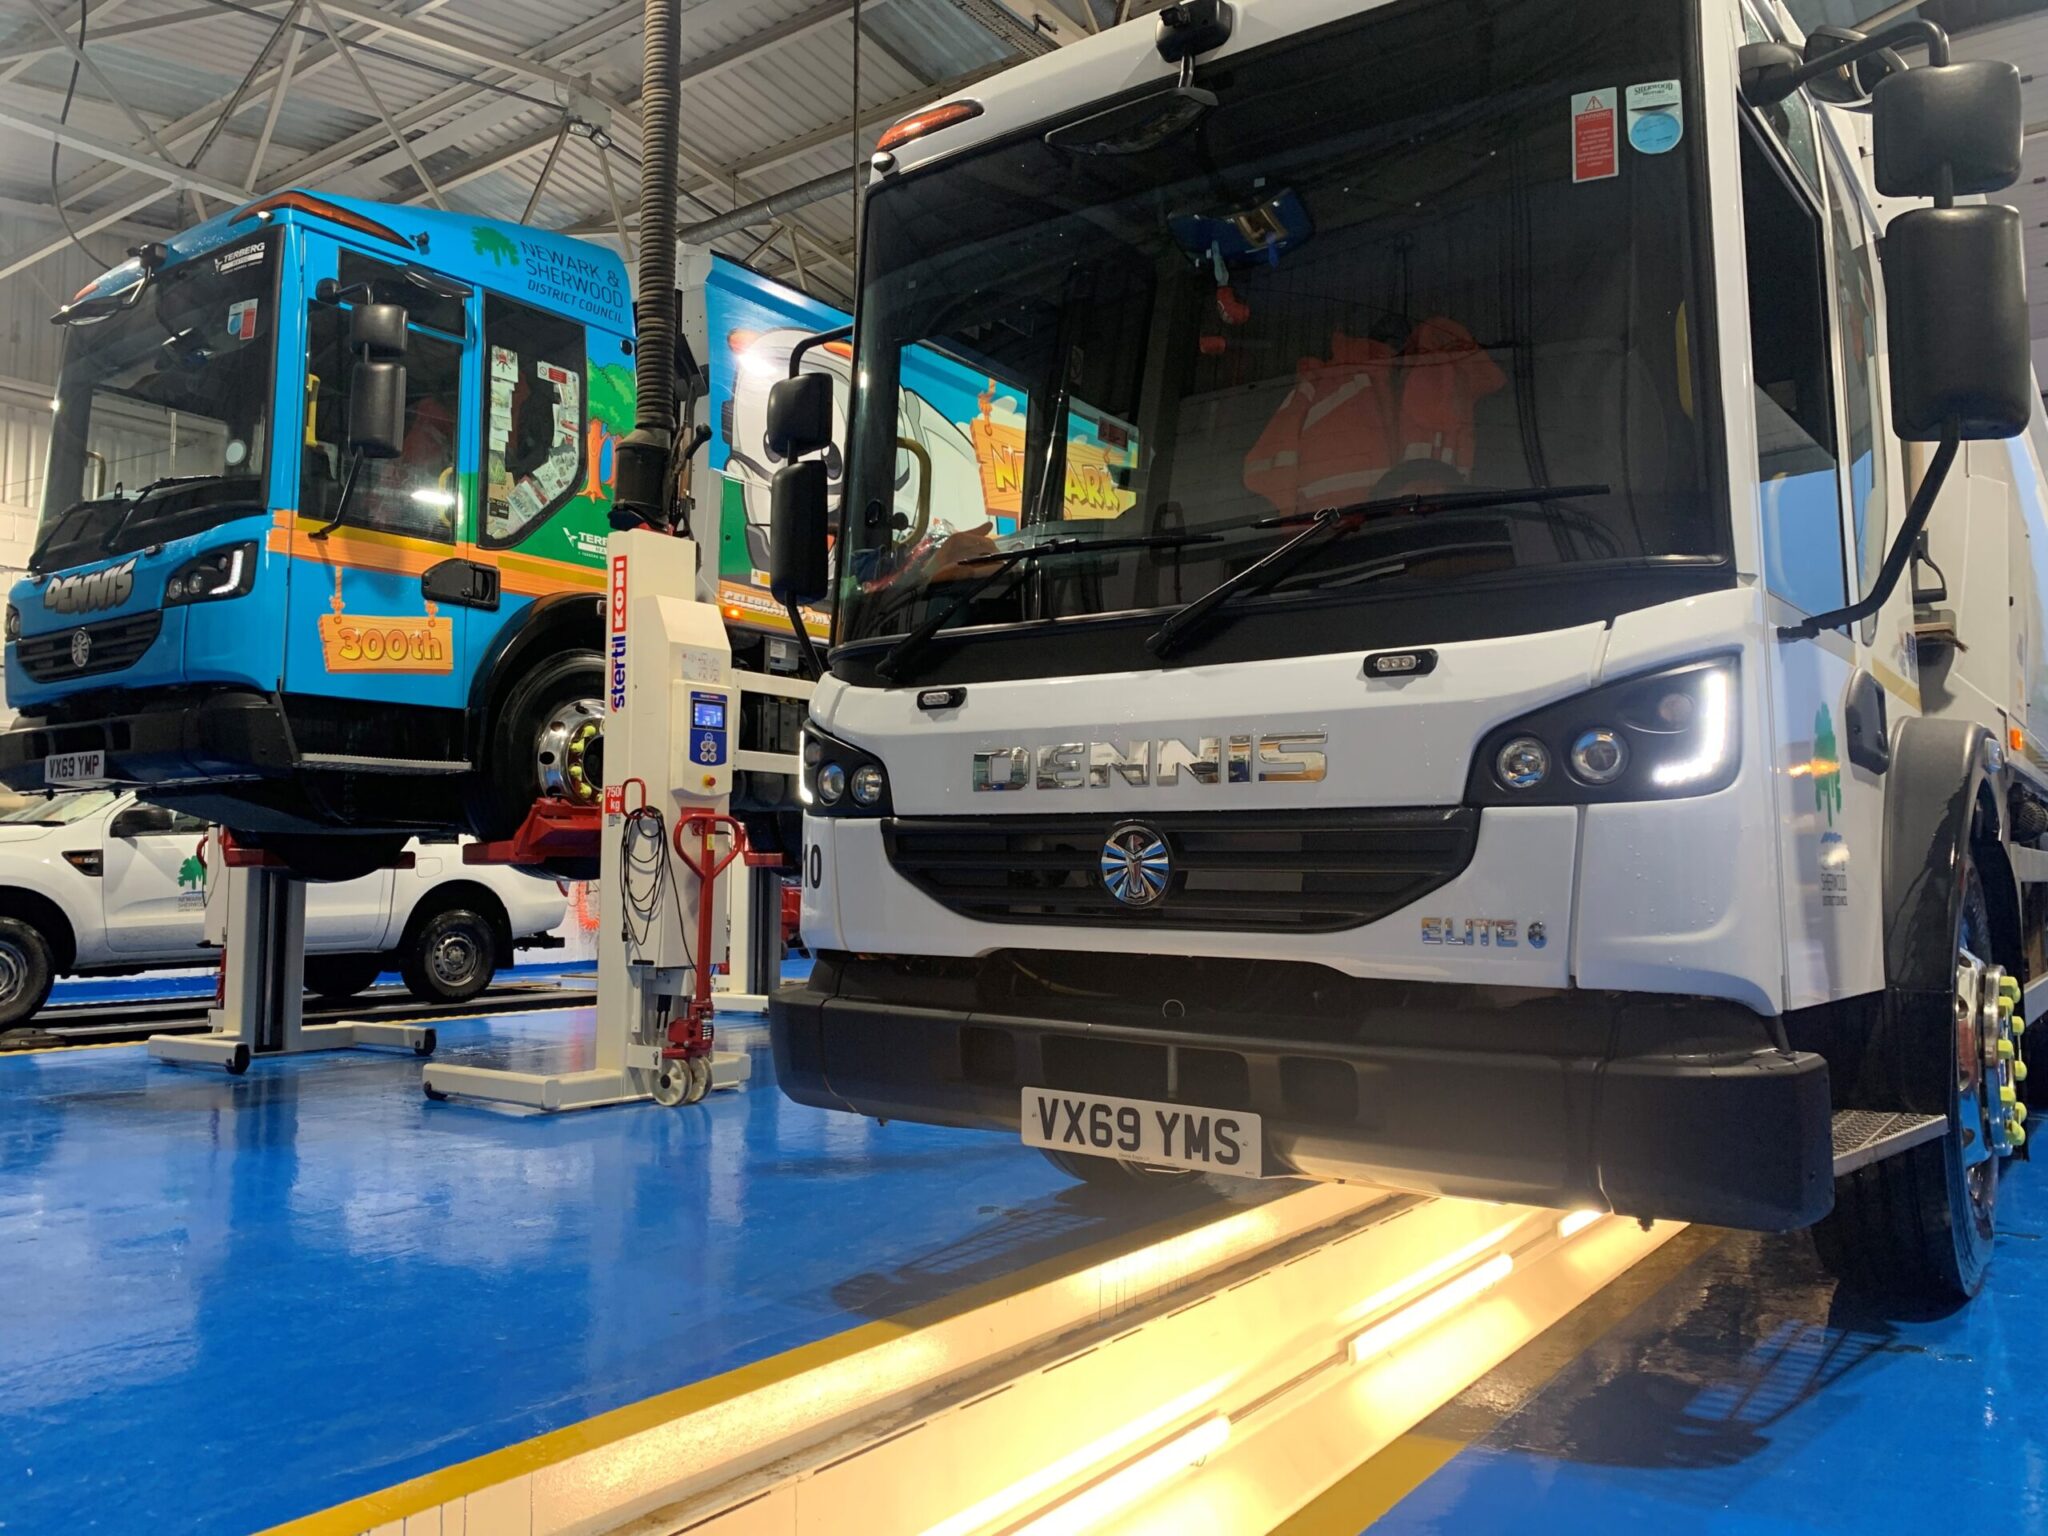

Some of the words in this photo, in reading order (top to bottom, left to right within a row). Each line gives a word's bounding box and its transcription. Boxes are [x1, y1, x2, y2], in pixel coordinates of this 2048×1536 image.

[1634, 82, 1673, 94] SHERWOOD
[223, 242, 265, 263] TERBERG
[520, 240, 600, 279] NEWARK
[607, 270, 619, 288] &
[525, 258, 624, 308] SHERWOOD
[527, 279, 577, 306] DISTRICT
[578, 298, 623, 323] COUNCIL
[44, 556, 138, 614] DENNIS
[613, 558, 627, 631] KONI
[338, 627, 443, 661] 300th
[611, 635, 627, 713] stertil
[49, 757, 75, 778] VX69
[78, 755, 99, 776] YMP
[973, 731, 1328, 793] DENNIS
[610, 798, 620, 812] kg
[1421, 917, 1518, 948] ELITE
[1527, 920, 1547, 949] 6
[1037, 1096, 1141, 1152] VX69
[1155, 1110, 1241, 1166] YMS
